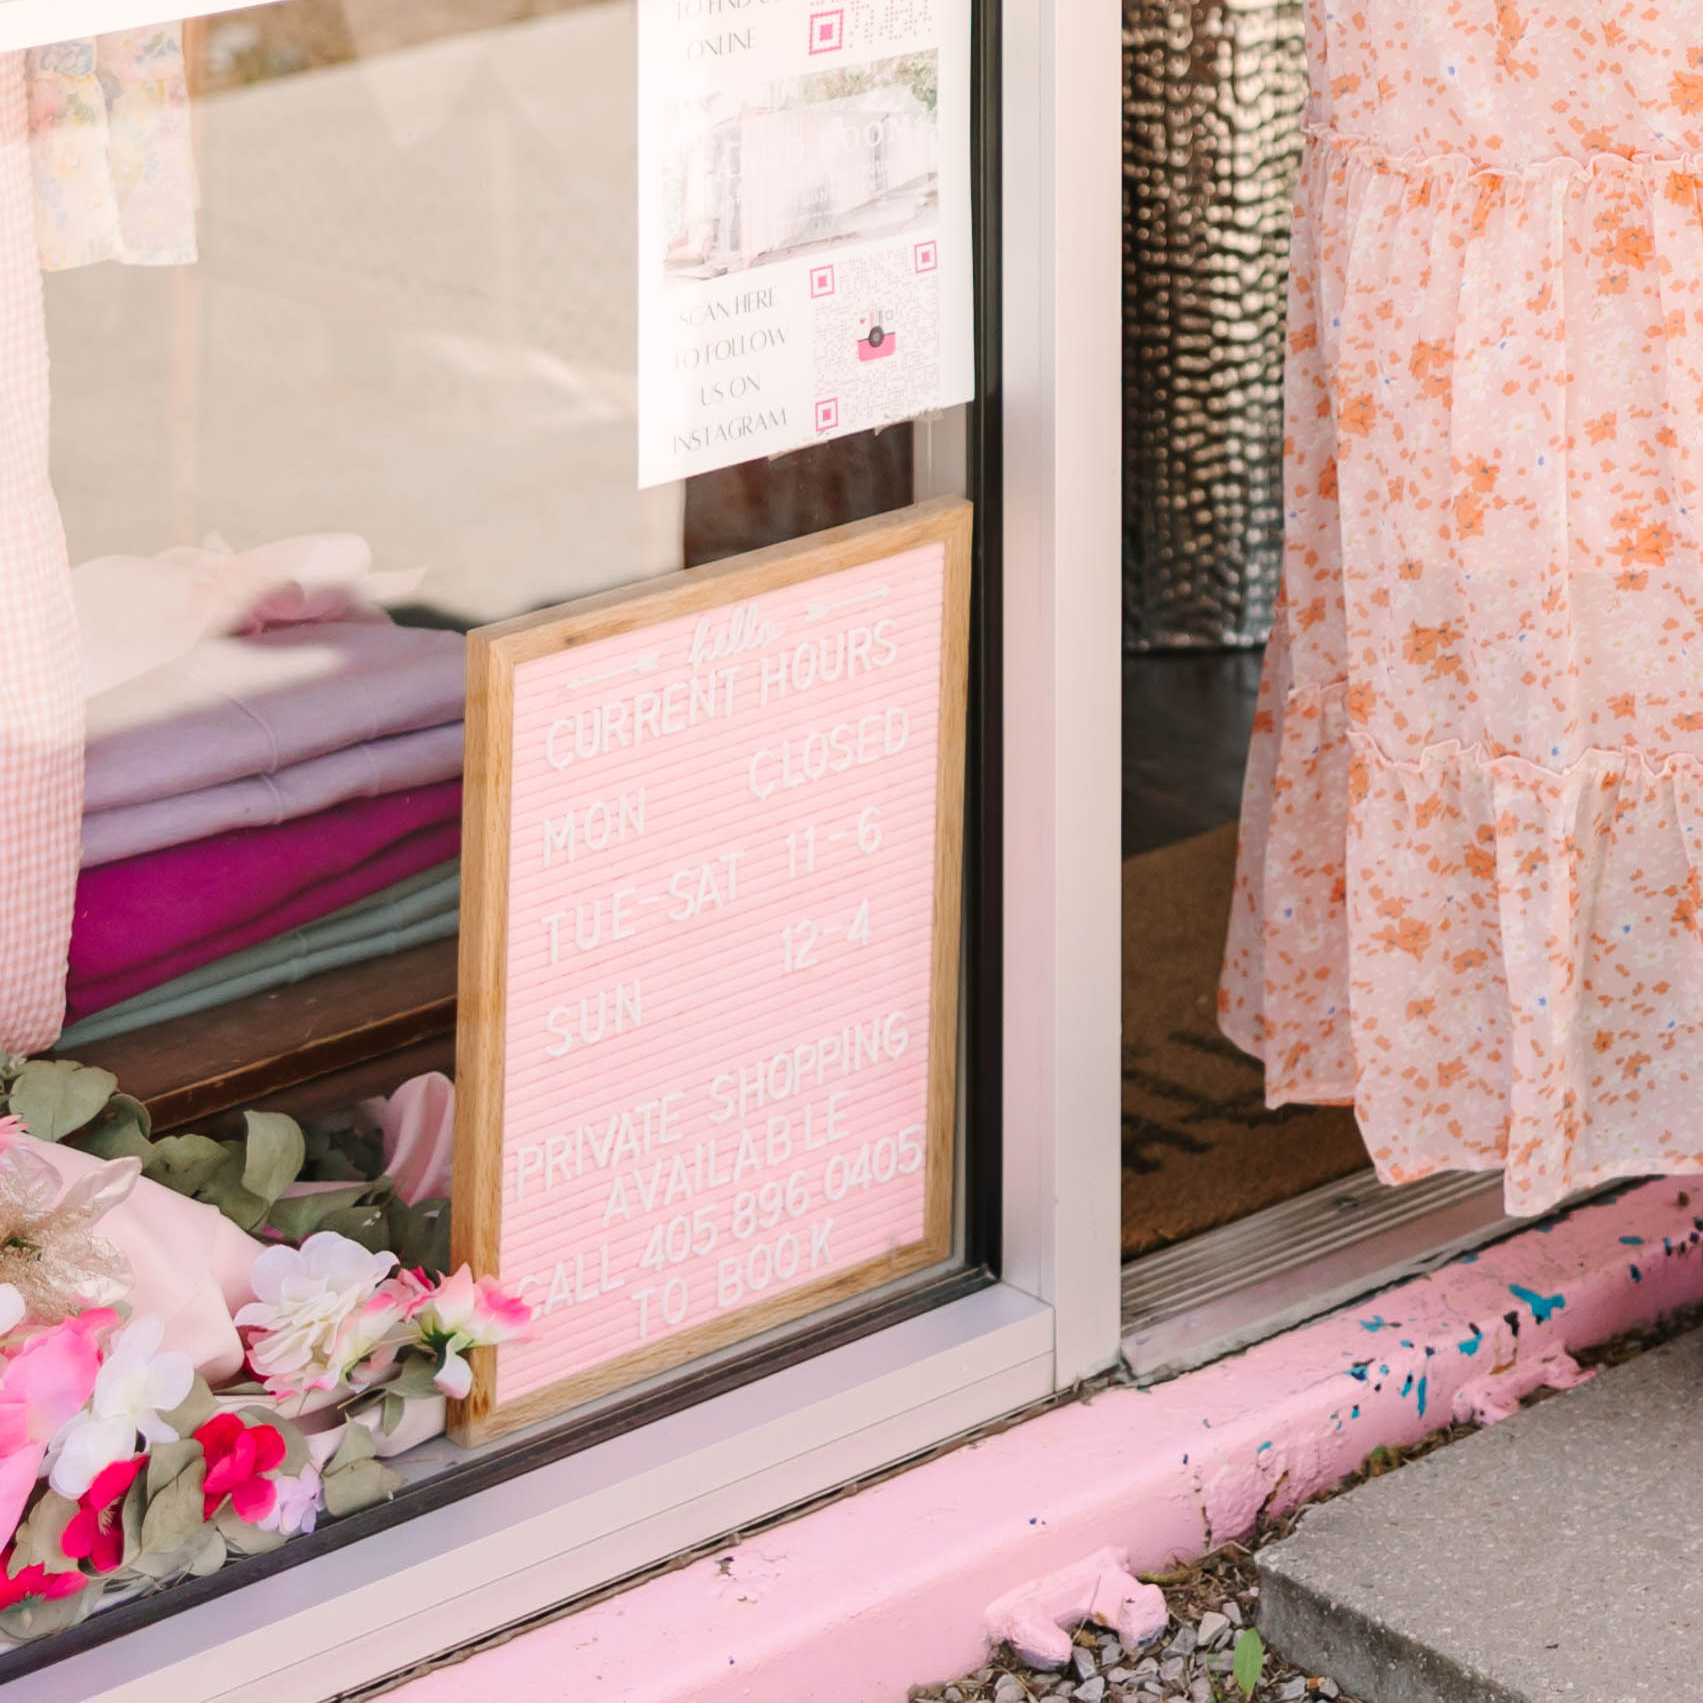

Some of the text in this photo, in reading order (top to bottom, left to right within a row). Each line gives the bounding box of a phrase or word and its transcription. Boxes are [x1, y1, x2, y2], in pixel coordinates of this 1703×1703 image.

[687, 26, 757, 60] ONLINE
[679, 286, 777, 329] SCAN HERE
[705, 326, 789, 364] FOLLOW
[672, 407, 788, 456] INSTAGRAM
[701, 373, 761, 406] US ON
[688, 601, 784, 668] hello
[545, 617, 899, 772] CURRENT HOURS
[542, 706, 911, 868] MON CLOSED
[541, 849, 746, 965] TUE-SAT
[545, 977, 644, 1058] SUN
[514, 1009, 910, 1202] PRIVATE SHOPPING
[601, 1088, 852, 1229] AVAILABLE
[516, 1123, 928, 1324] CALL 405 896 0405
[631, 1217, 836, 1340] TO BOOK
